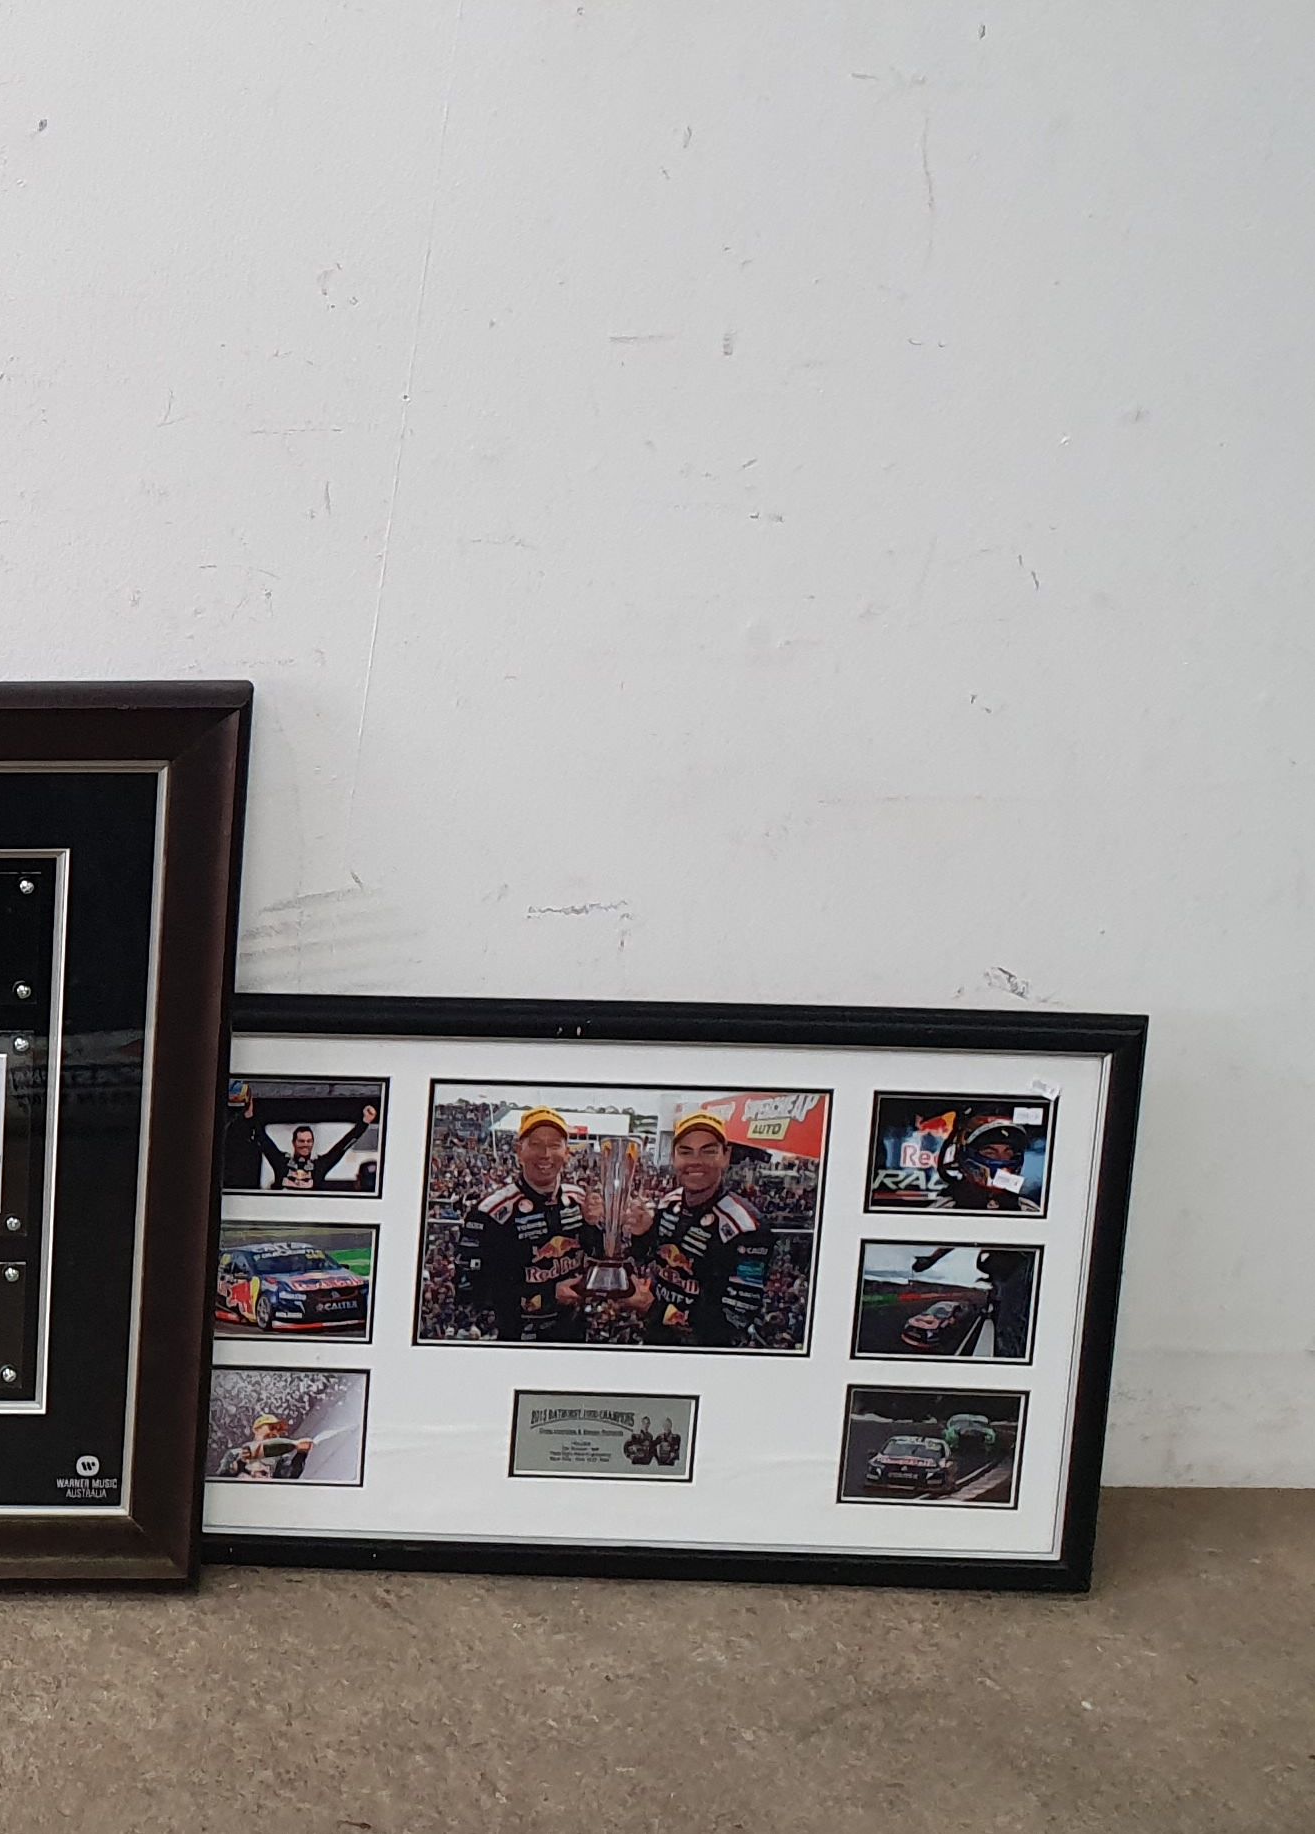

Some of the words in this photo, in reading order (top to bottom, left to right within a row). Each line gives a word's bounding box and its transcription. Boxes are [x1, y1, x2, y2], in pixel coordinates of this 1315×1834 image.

[752, 1123, 782, 1135] AUTO
[91, 1478, 118, 1488] MUSIC
[65, 1488, 107, 1498] AUSTRALIA
